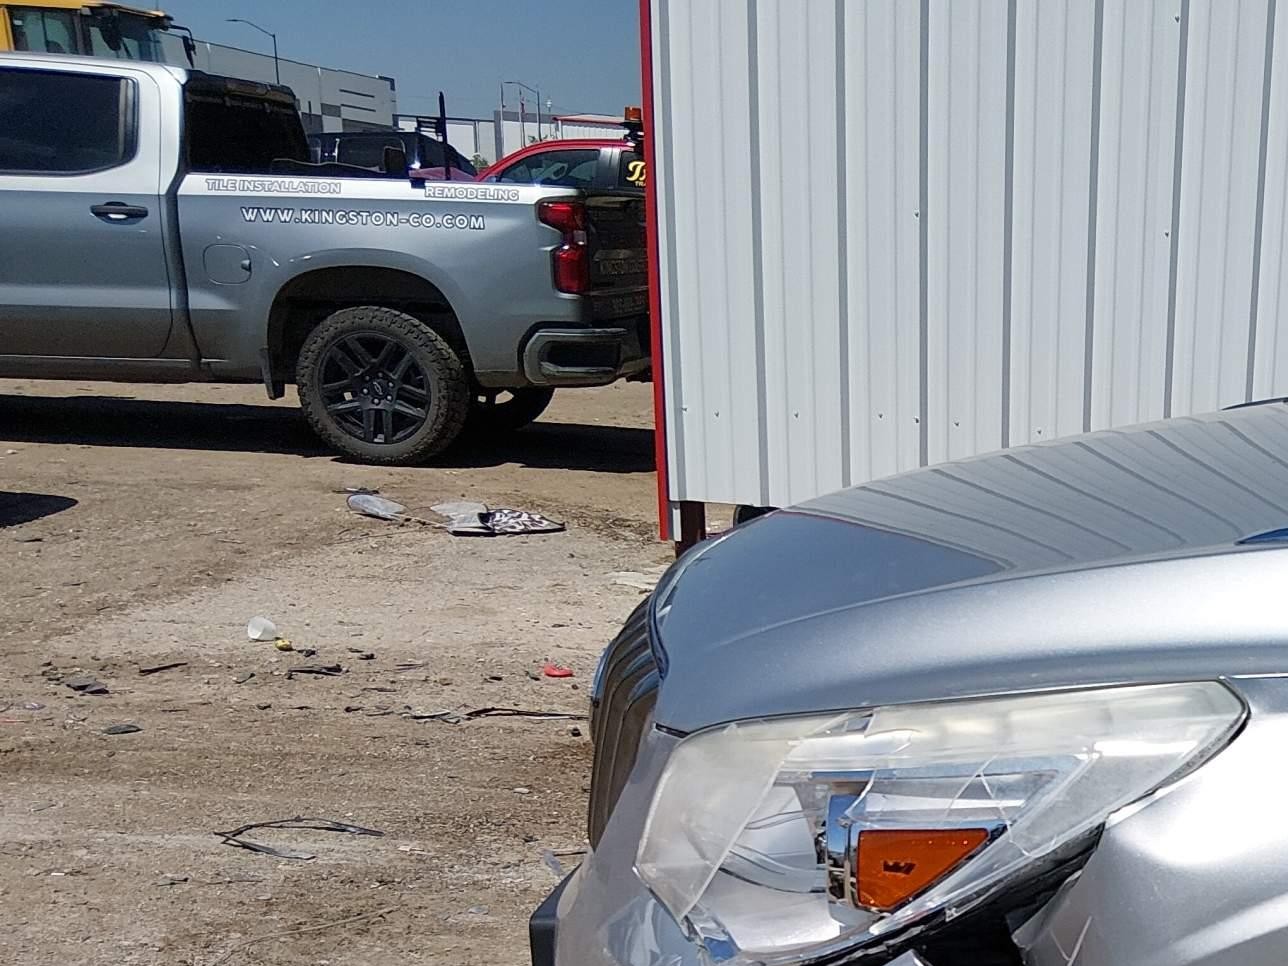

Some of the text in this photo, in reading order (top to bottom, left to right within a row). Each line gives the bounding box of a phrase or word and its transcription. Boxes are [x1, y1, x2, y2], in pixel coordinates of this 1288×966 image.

[206, 178, 341, 194] TILE INSTALLATION
[424, 186, 519, 201] REMODELING
[240, 207, 485, 230] WWW.KINGSTON-CO.COM
